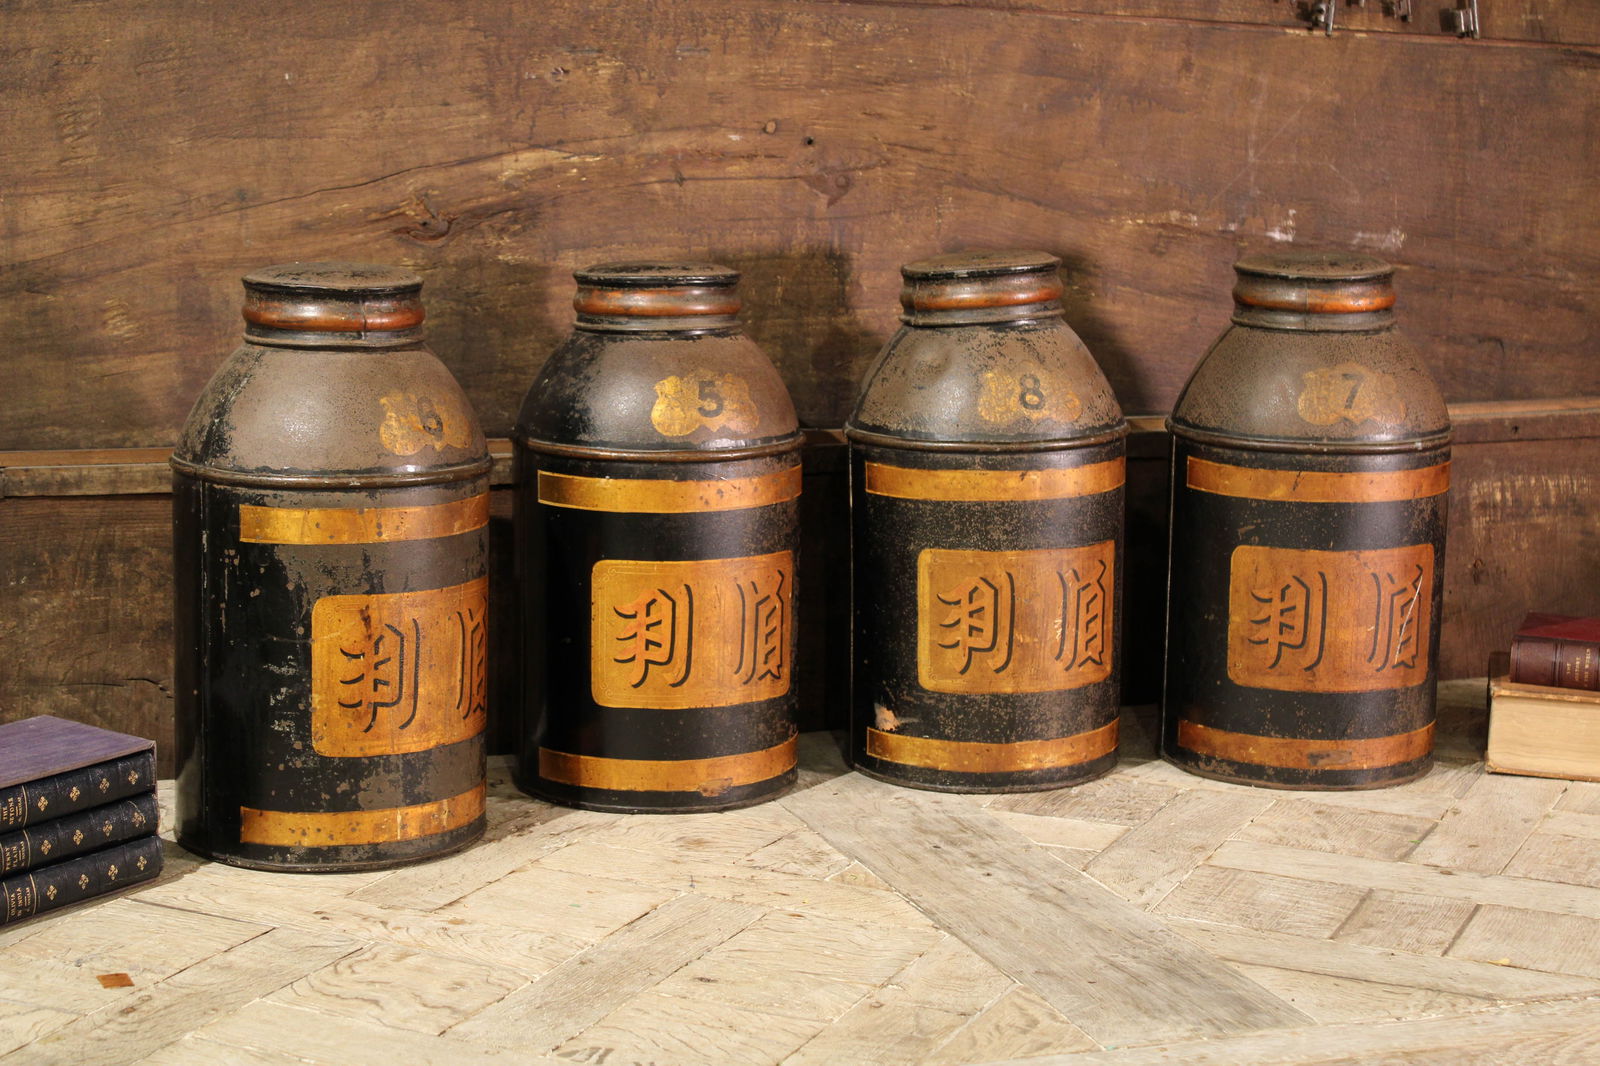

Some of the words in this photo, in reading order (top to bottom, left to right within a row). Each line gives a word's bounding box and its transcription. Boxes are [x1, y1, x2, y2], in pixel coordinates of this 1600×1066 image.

[698, 380, 724, 418] 5
[1019, 373, 1046, 411] 8
[1341, 373, 1365, 410] 7
